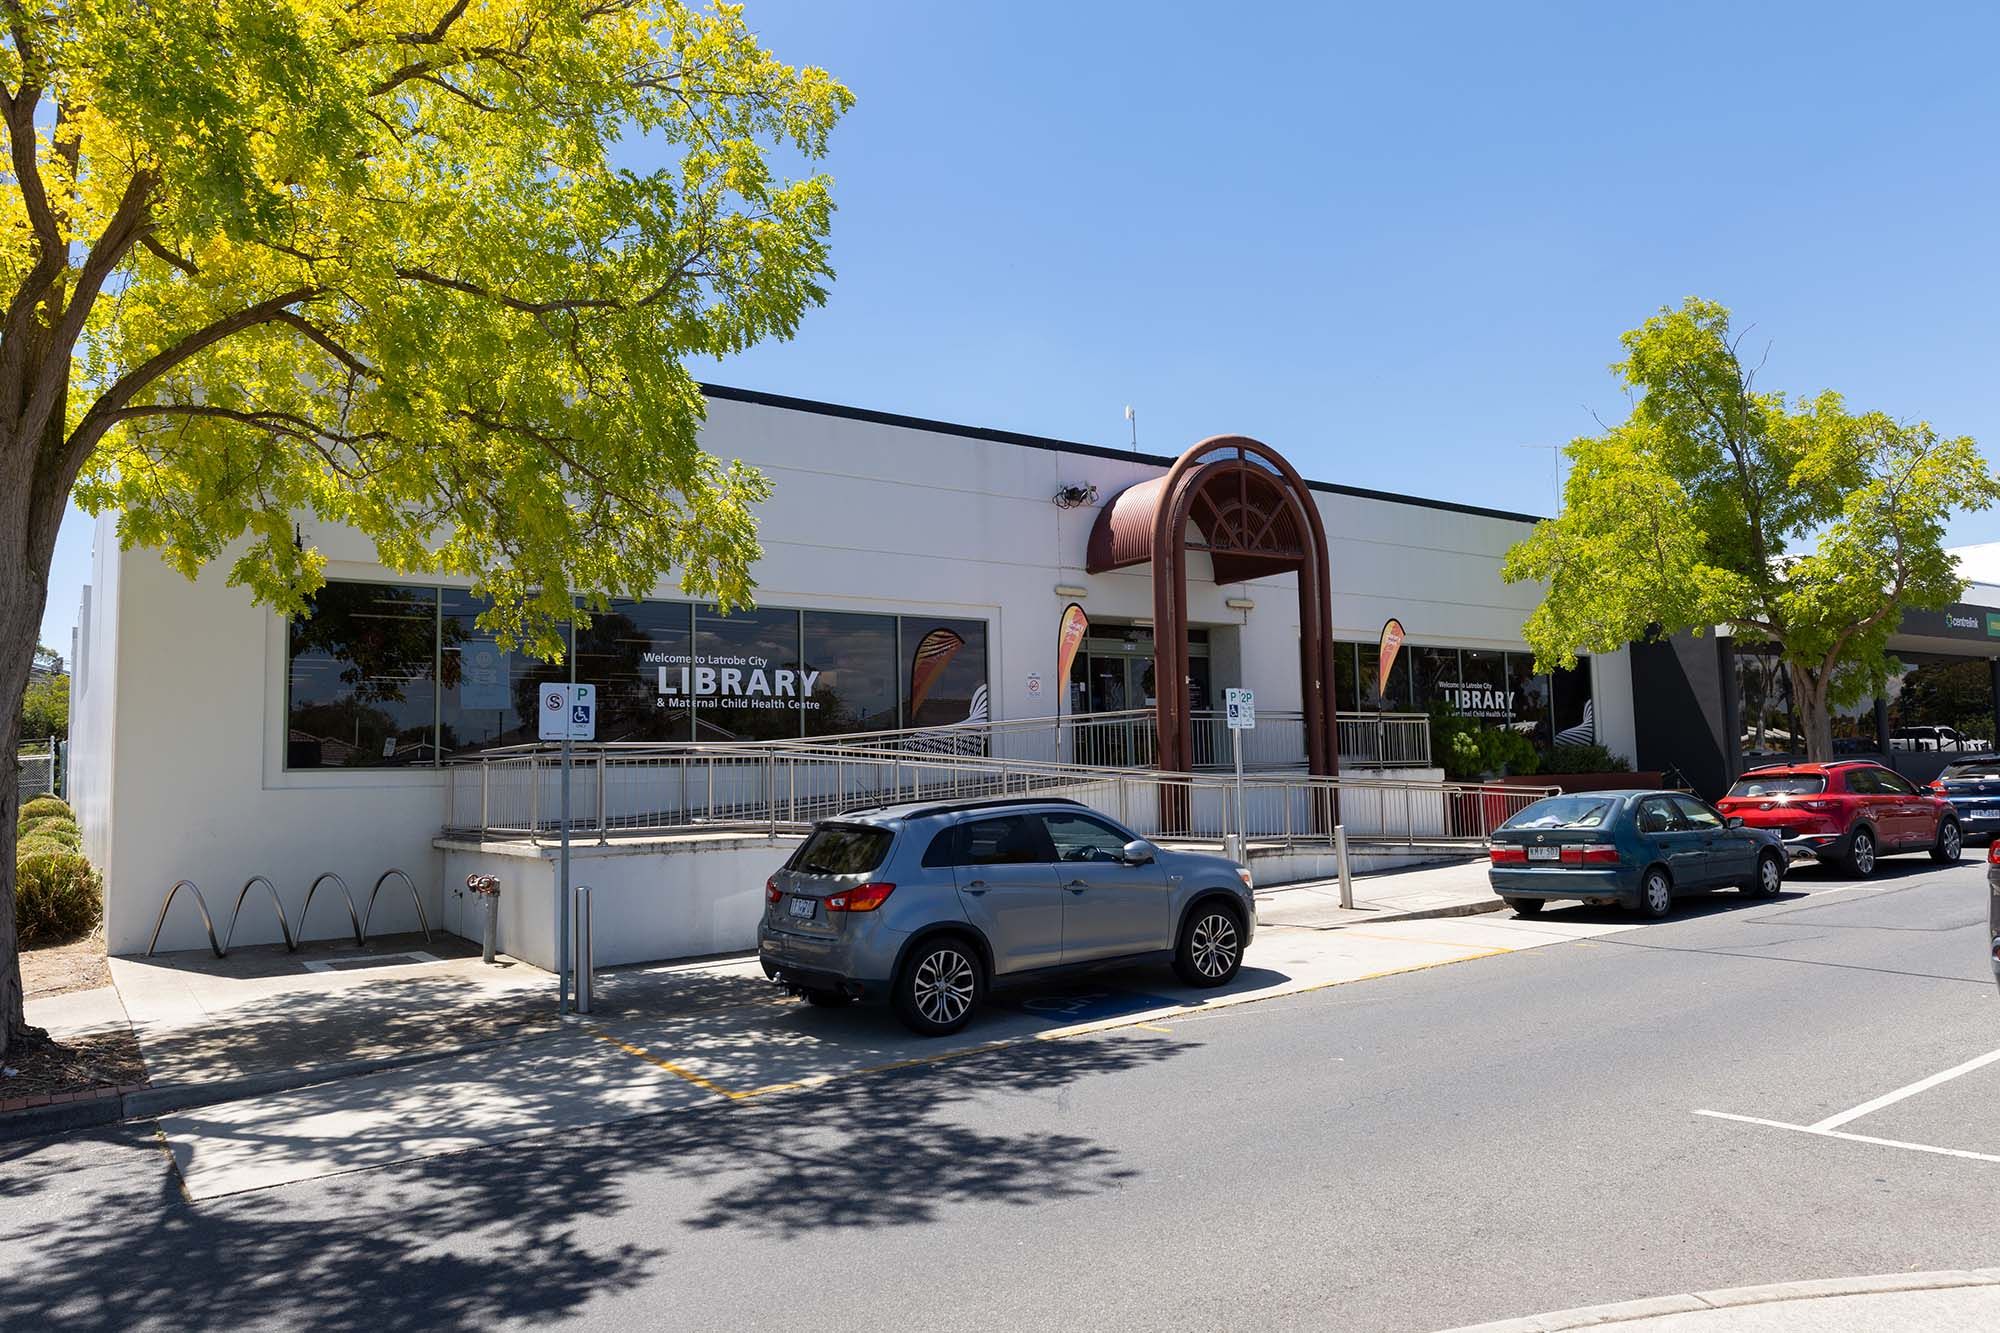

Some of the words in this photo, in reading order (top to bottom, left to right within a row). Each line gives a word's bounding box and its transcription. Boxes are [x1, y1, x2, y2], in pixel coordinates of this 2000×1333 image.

[643, 652, 691, 664] Welcome
[695, 655, 706, 664] to
[708, 655, 746, 665] Latrobe
[748, 656, 768, 668] City
[658, 666, 820, 697] LIBRARY
[577, 688, 588, 701] P
[1230, 692, 1237, 701] P
[1241, 692, 1252, 703] 2P
[656, 698, 666, 708] &
[721, 699, 748, 709] Child
[751, 699, 785, 709] Health
